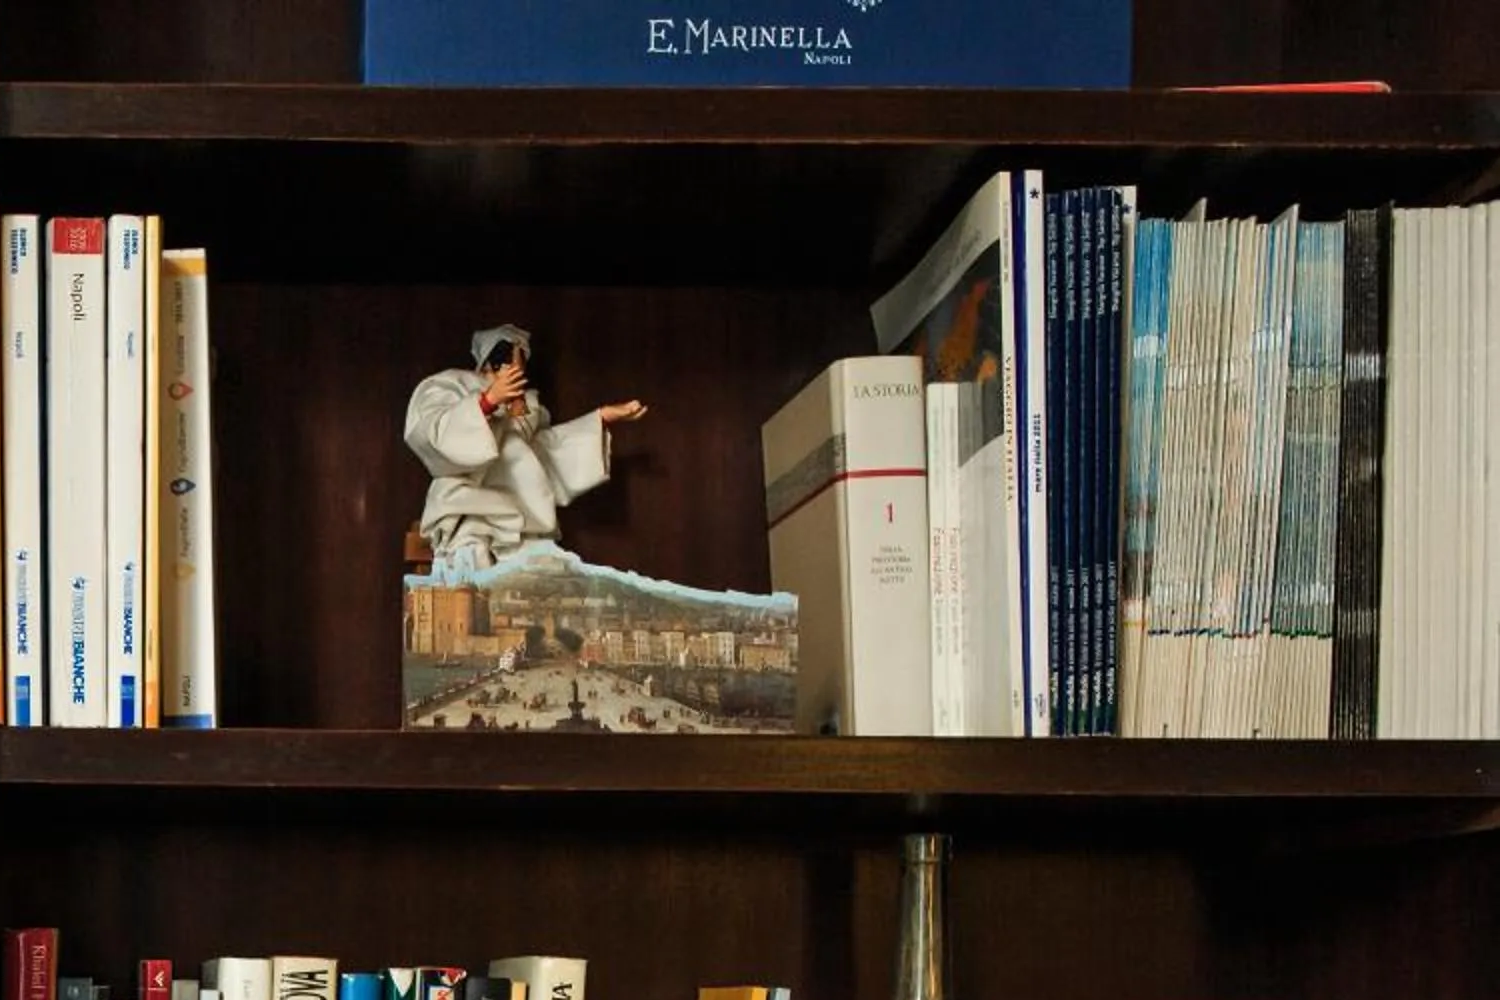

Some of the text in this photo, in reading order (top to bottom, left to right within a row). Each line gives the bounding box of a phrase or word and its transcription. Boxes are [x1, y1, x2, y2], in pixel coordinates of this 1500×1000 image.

[646, 18, 852, 55] E. MARINELLA
[803, 52, 851, 65] NAPOLI
[70, 272, 87, 322] Napoli
[853, 385, 870, 399] LA
[30, 944, 46, 990] Khaled
